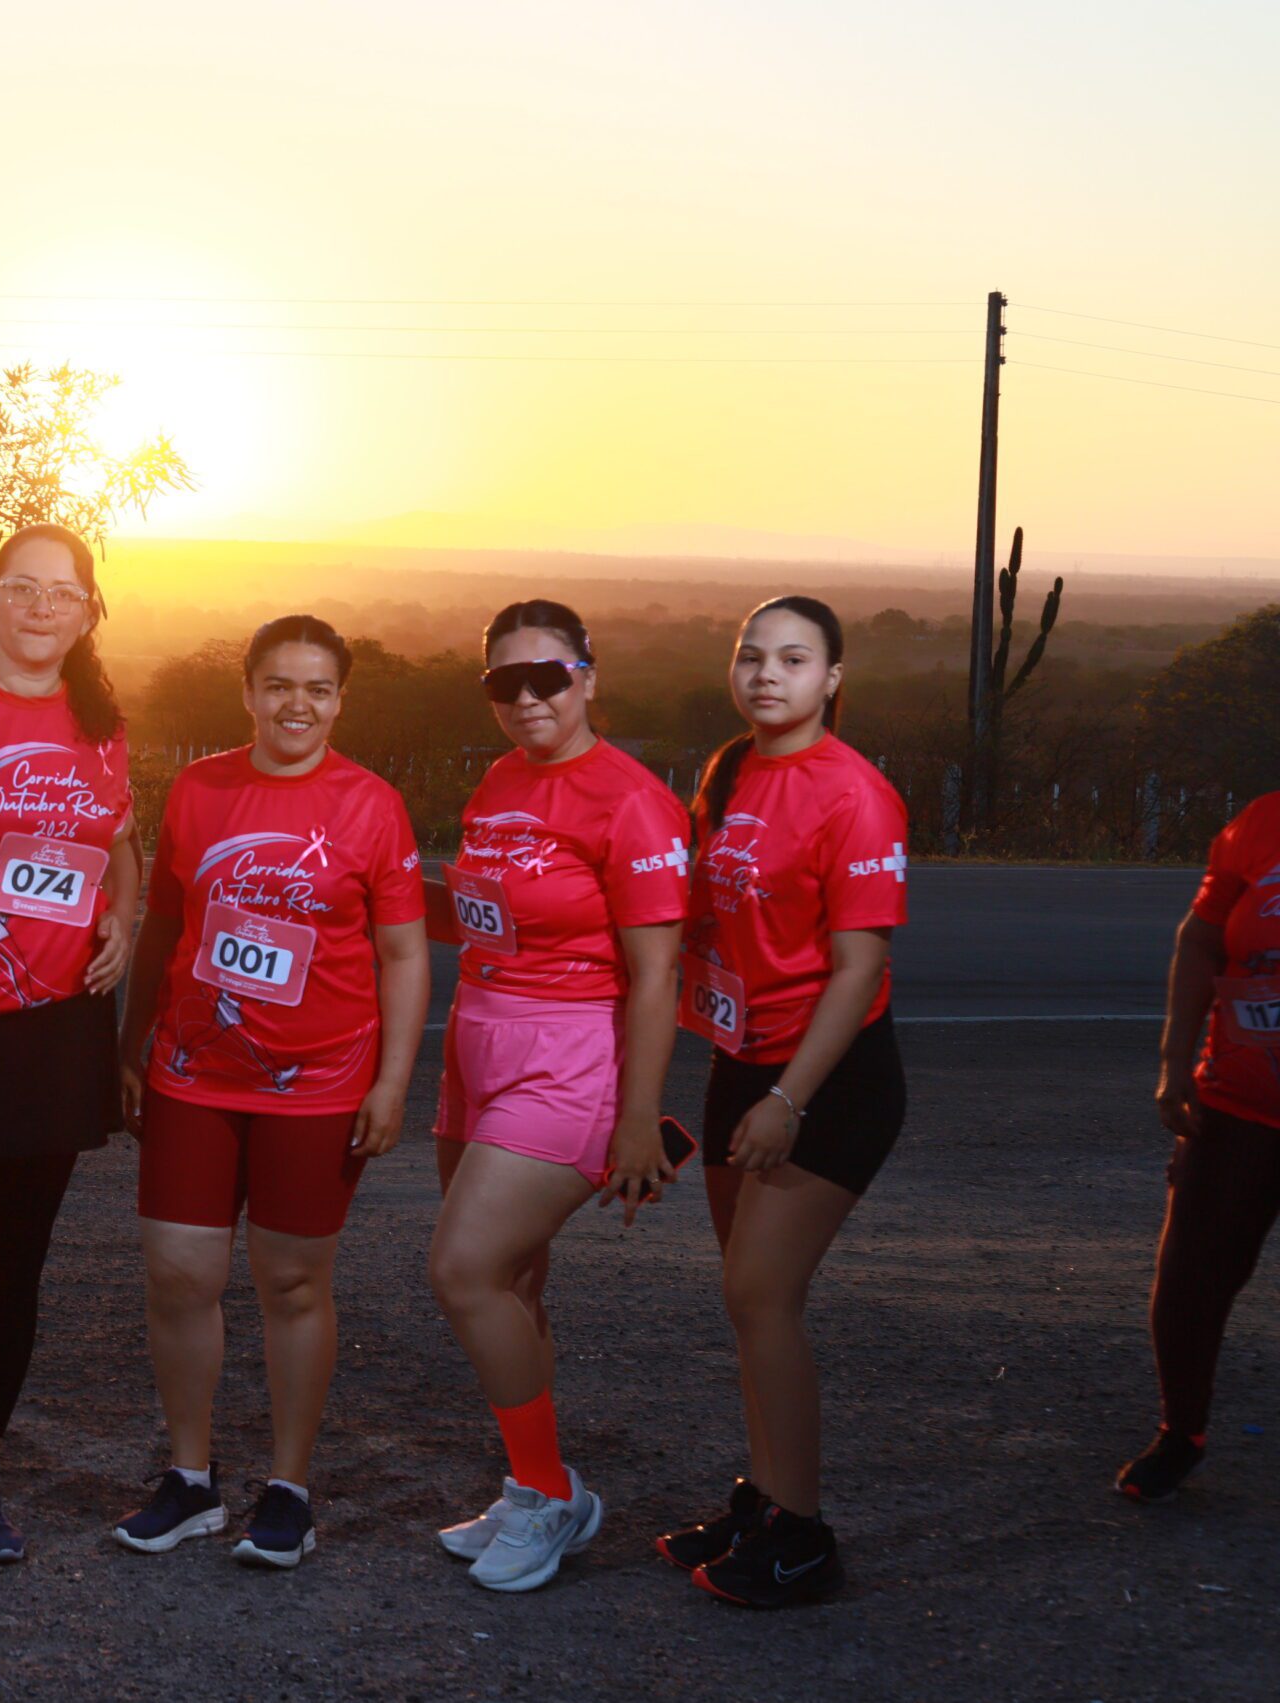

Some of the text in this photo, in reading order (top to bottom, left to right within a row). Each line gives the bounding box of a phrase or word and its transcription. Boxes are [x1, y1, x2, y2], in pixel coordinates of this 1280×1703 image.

[12, 760, 90, 789] Corrida
[32, 820, 80, 838] 2026
[232, 850, 315, 880] Corrida
[631, 854, 663, 874] SUS
[848, 857, 880, 877] SUS
[11, 864, 76, 901] 074
[208, 878, 280, 909] Outubro
[457, 896, 497, 932] 005
[219, 937, 278, 979] 001
[695, 984, 732, 1028] 092
